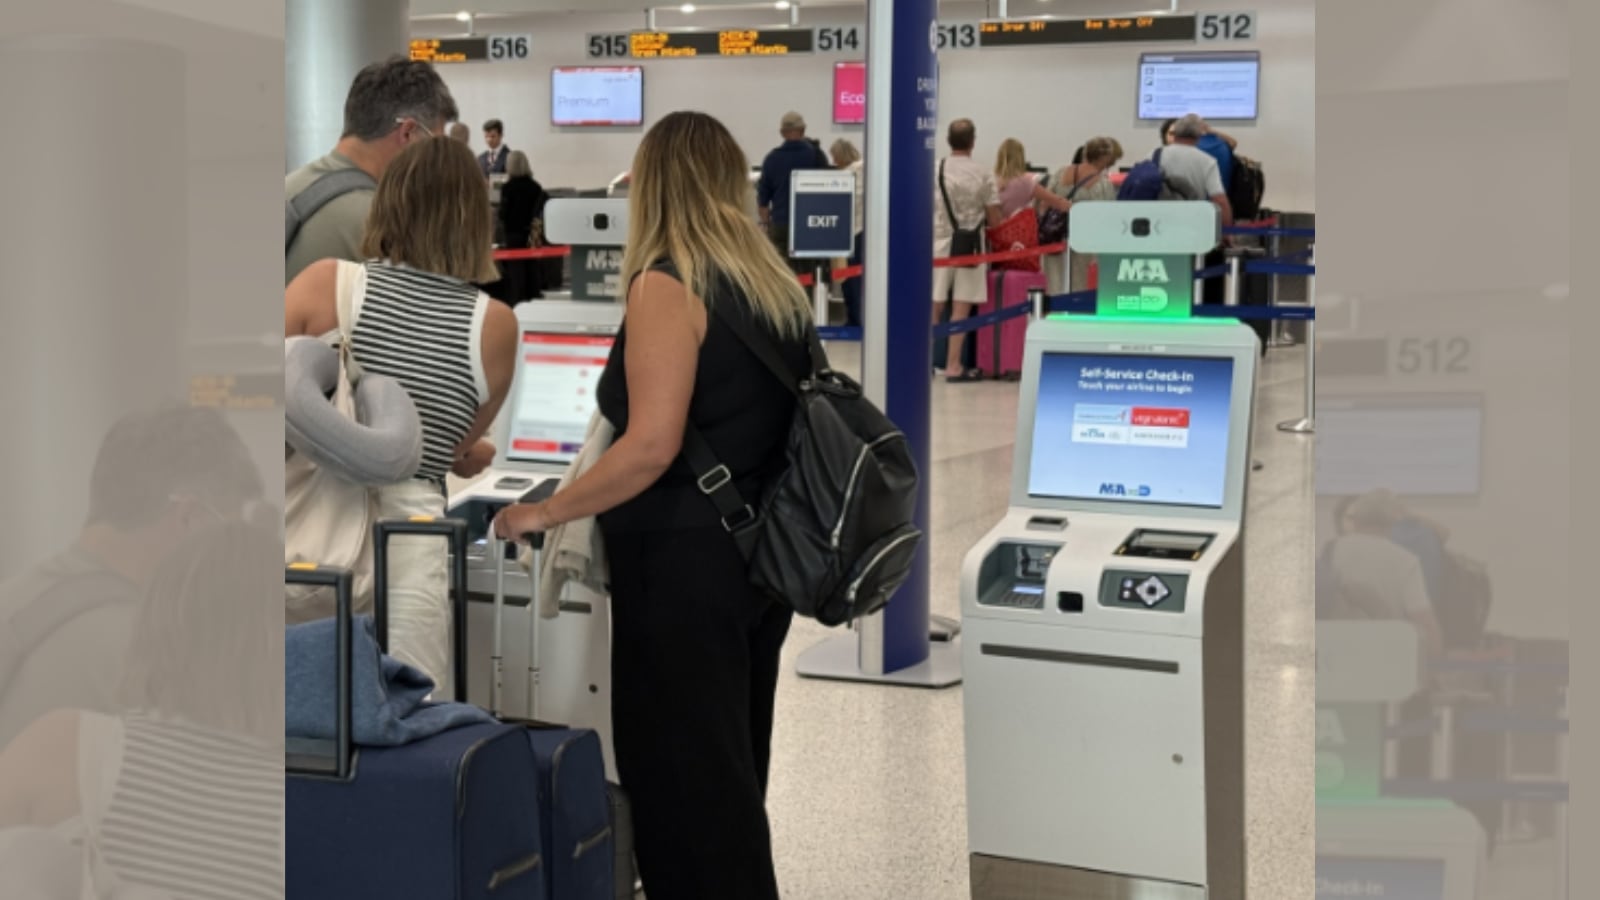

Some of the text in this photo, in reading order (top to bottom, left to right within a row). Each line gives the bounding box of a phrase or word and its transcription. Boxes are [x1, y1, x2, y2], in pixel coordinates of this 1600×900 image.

[936, 25, 975, 47] 513
[1201, 15, 1250, 38] 512
[491, 37, 528, 58] 516
[589, 35, 627, 57] 515
[818, 29, 858, 50] 514
[808, 215, 839, 227] EXIT
[1397, 337, 1470, 374] 512
[1080, 367, 1144, 379] Self-Service
[1078, 380, 1193, 394] Touch your airline to begin
